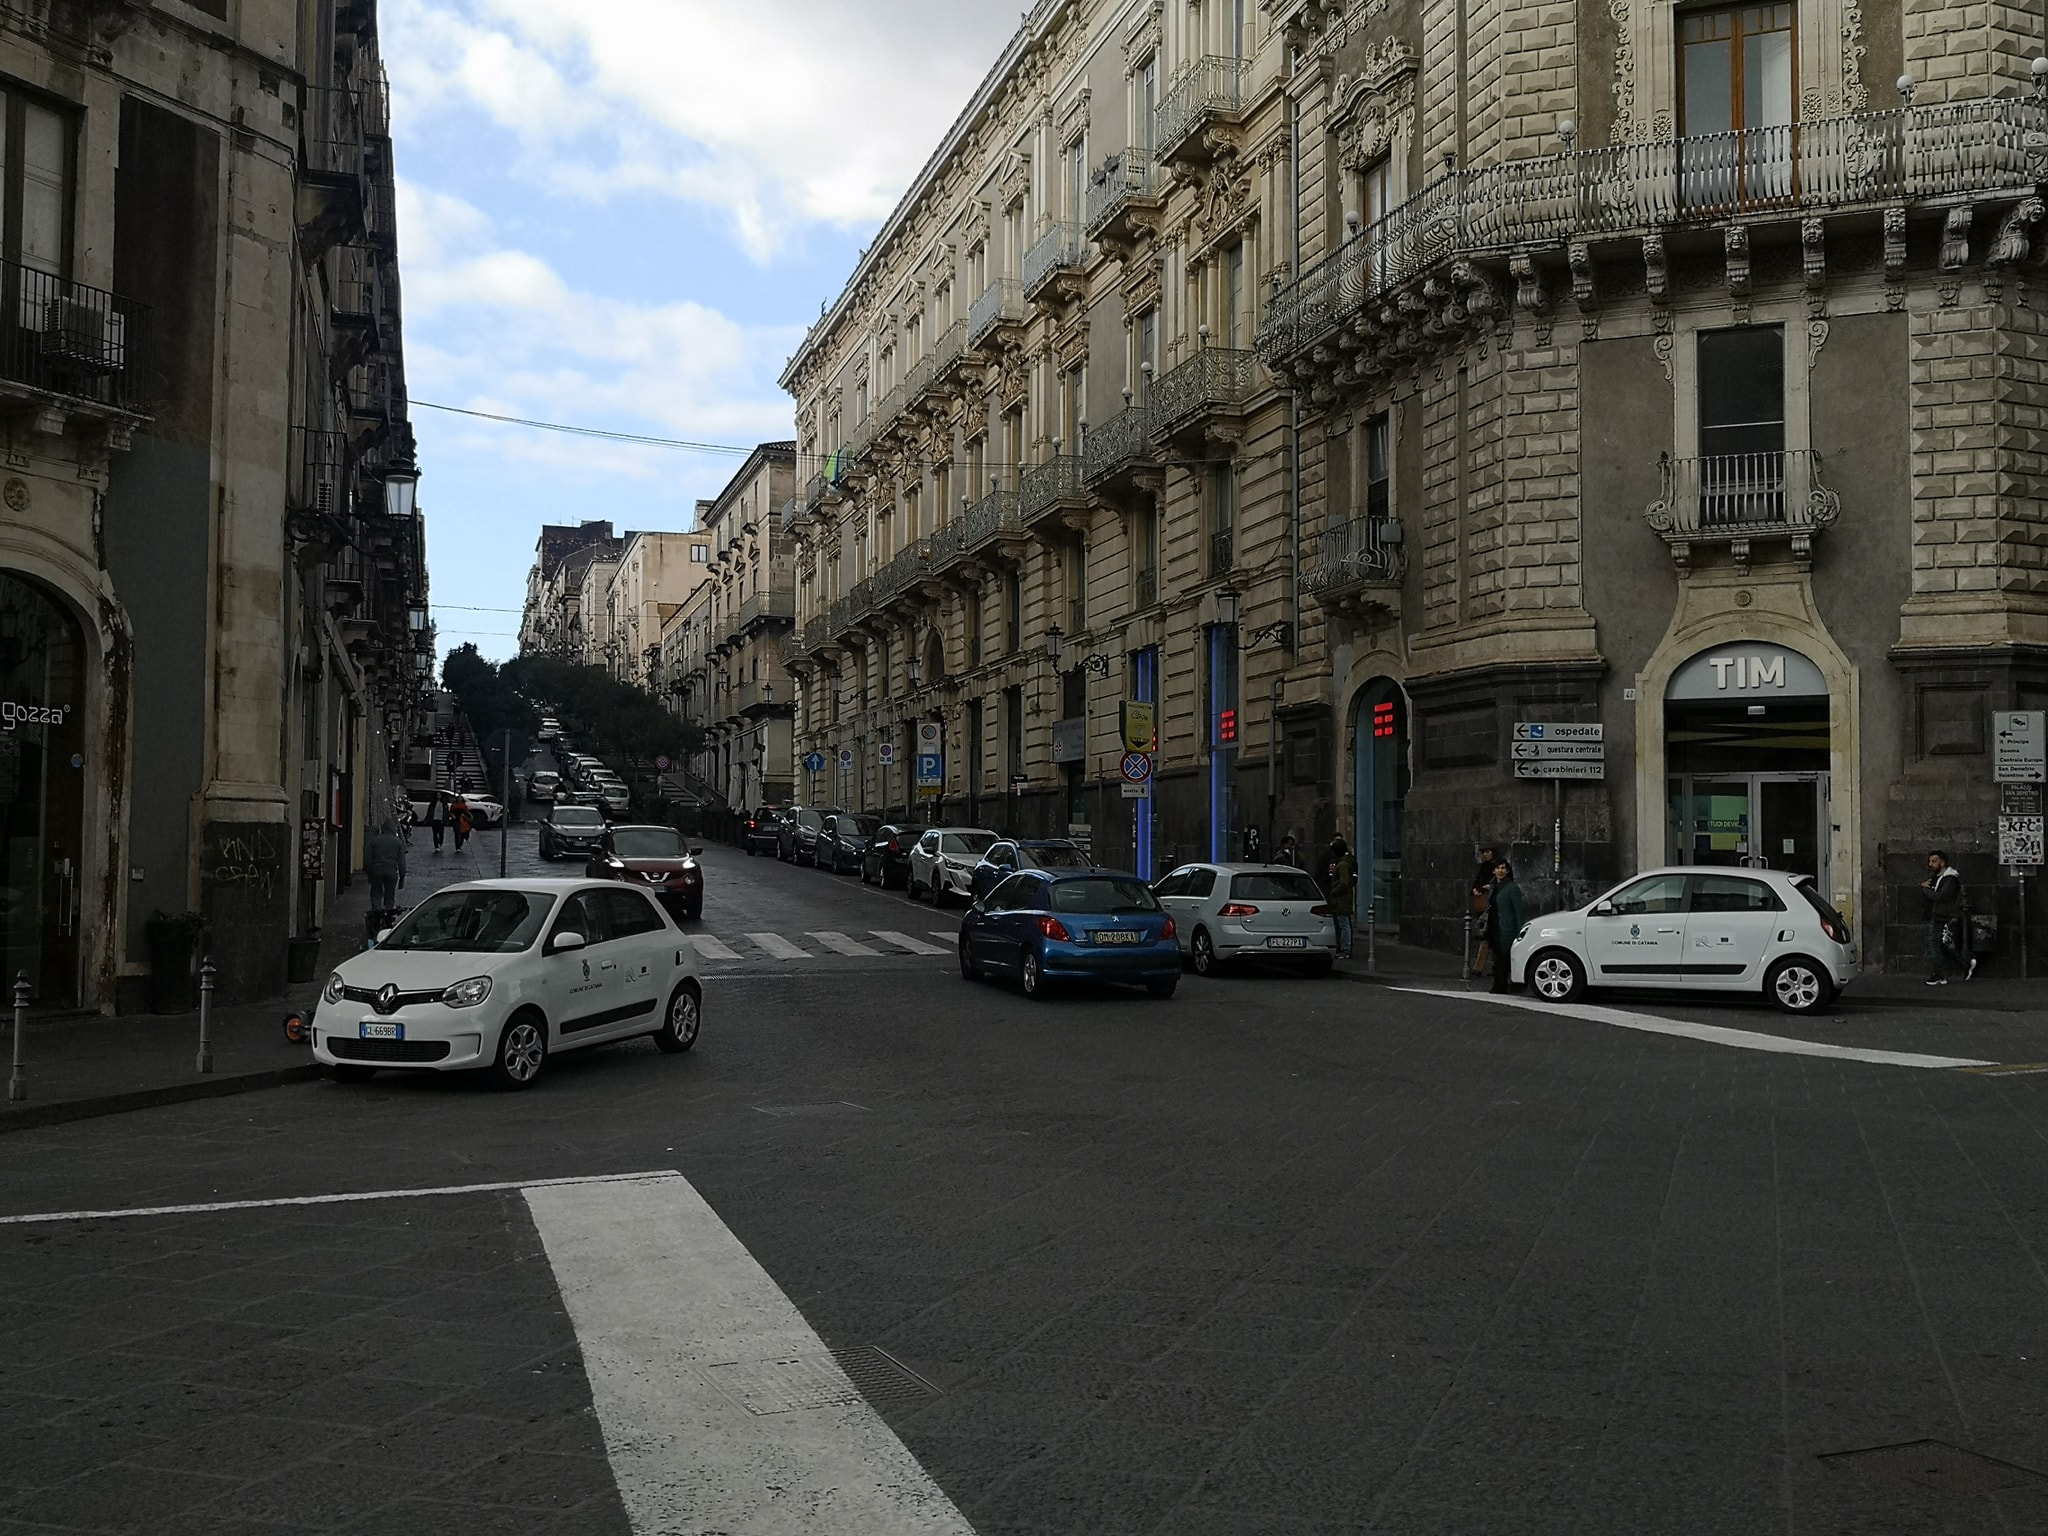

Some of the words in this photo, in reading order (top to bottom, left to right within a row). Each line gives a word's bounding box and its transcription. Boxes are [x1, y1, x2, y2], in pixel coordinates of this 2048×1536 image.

[1709, 655, 1786, 690] TIM
[1554, 727, 1600, 737] ospedale
[1546, 745, 1574, 754] questura
[1575, 745, 1602, 754] centrale
[1542, 765, 1587, 774] carabinieri
[1589, 766, 1602, 774] 112
[2007, 821, 2036, 832] KFC
